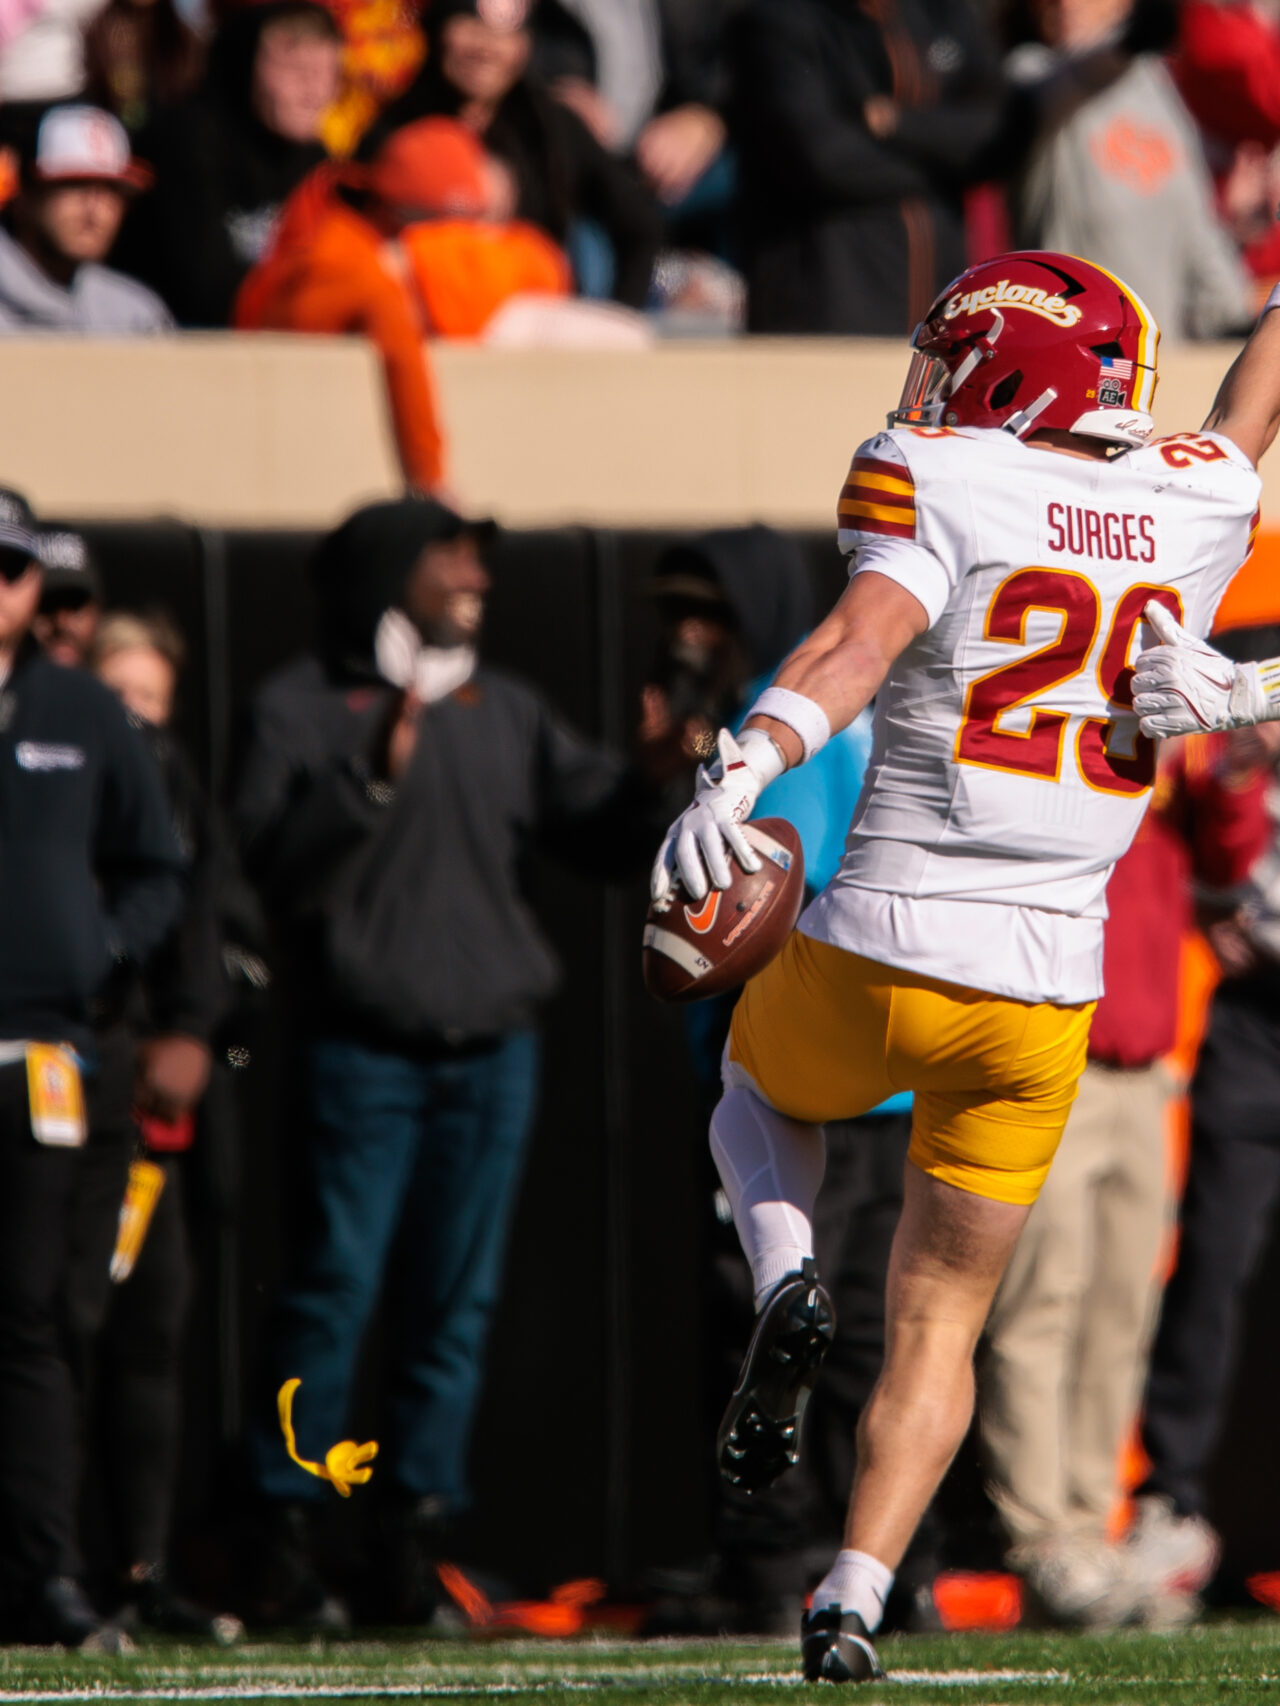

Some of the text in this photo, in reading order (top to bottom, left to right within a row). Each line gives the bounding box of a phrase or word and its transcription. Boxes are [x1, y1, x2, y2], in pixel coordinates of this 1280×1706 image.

[944, 279, 1082, 328] Cyclones
[1101, 390, 1117, 404] AE
[1047, 502, 1156, 563] SURGES
